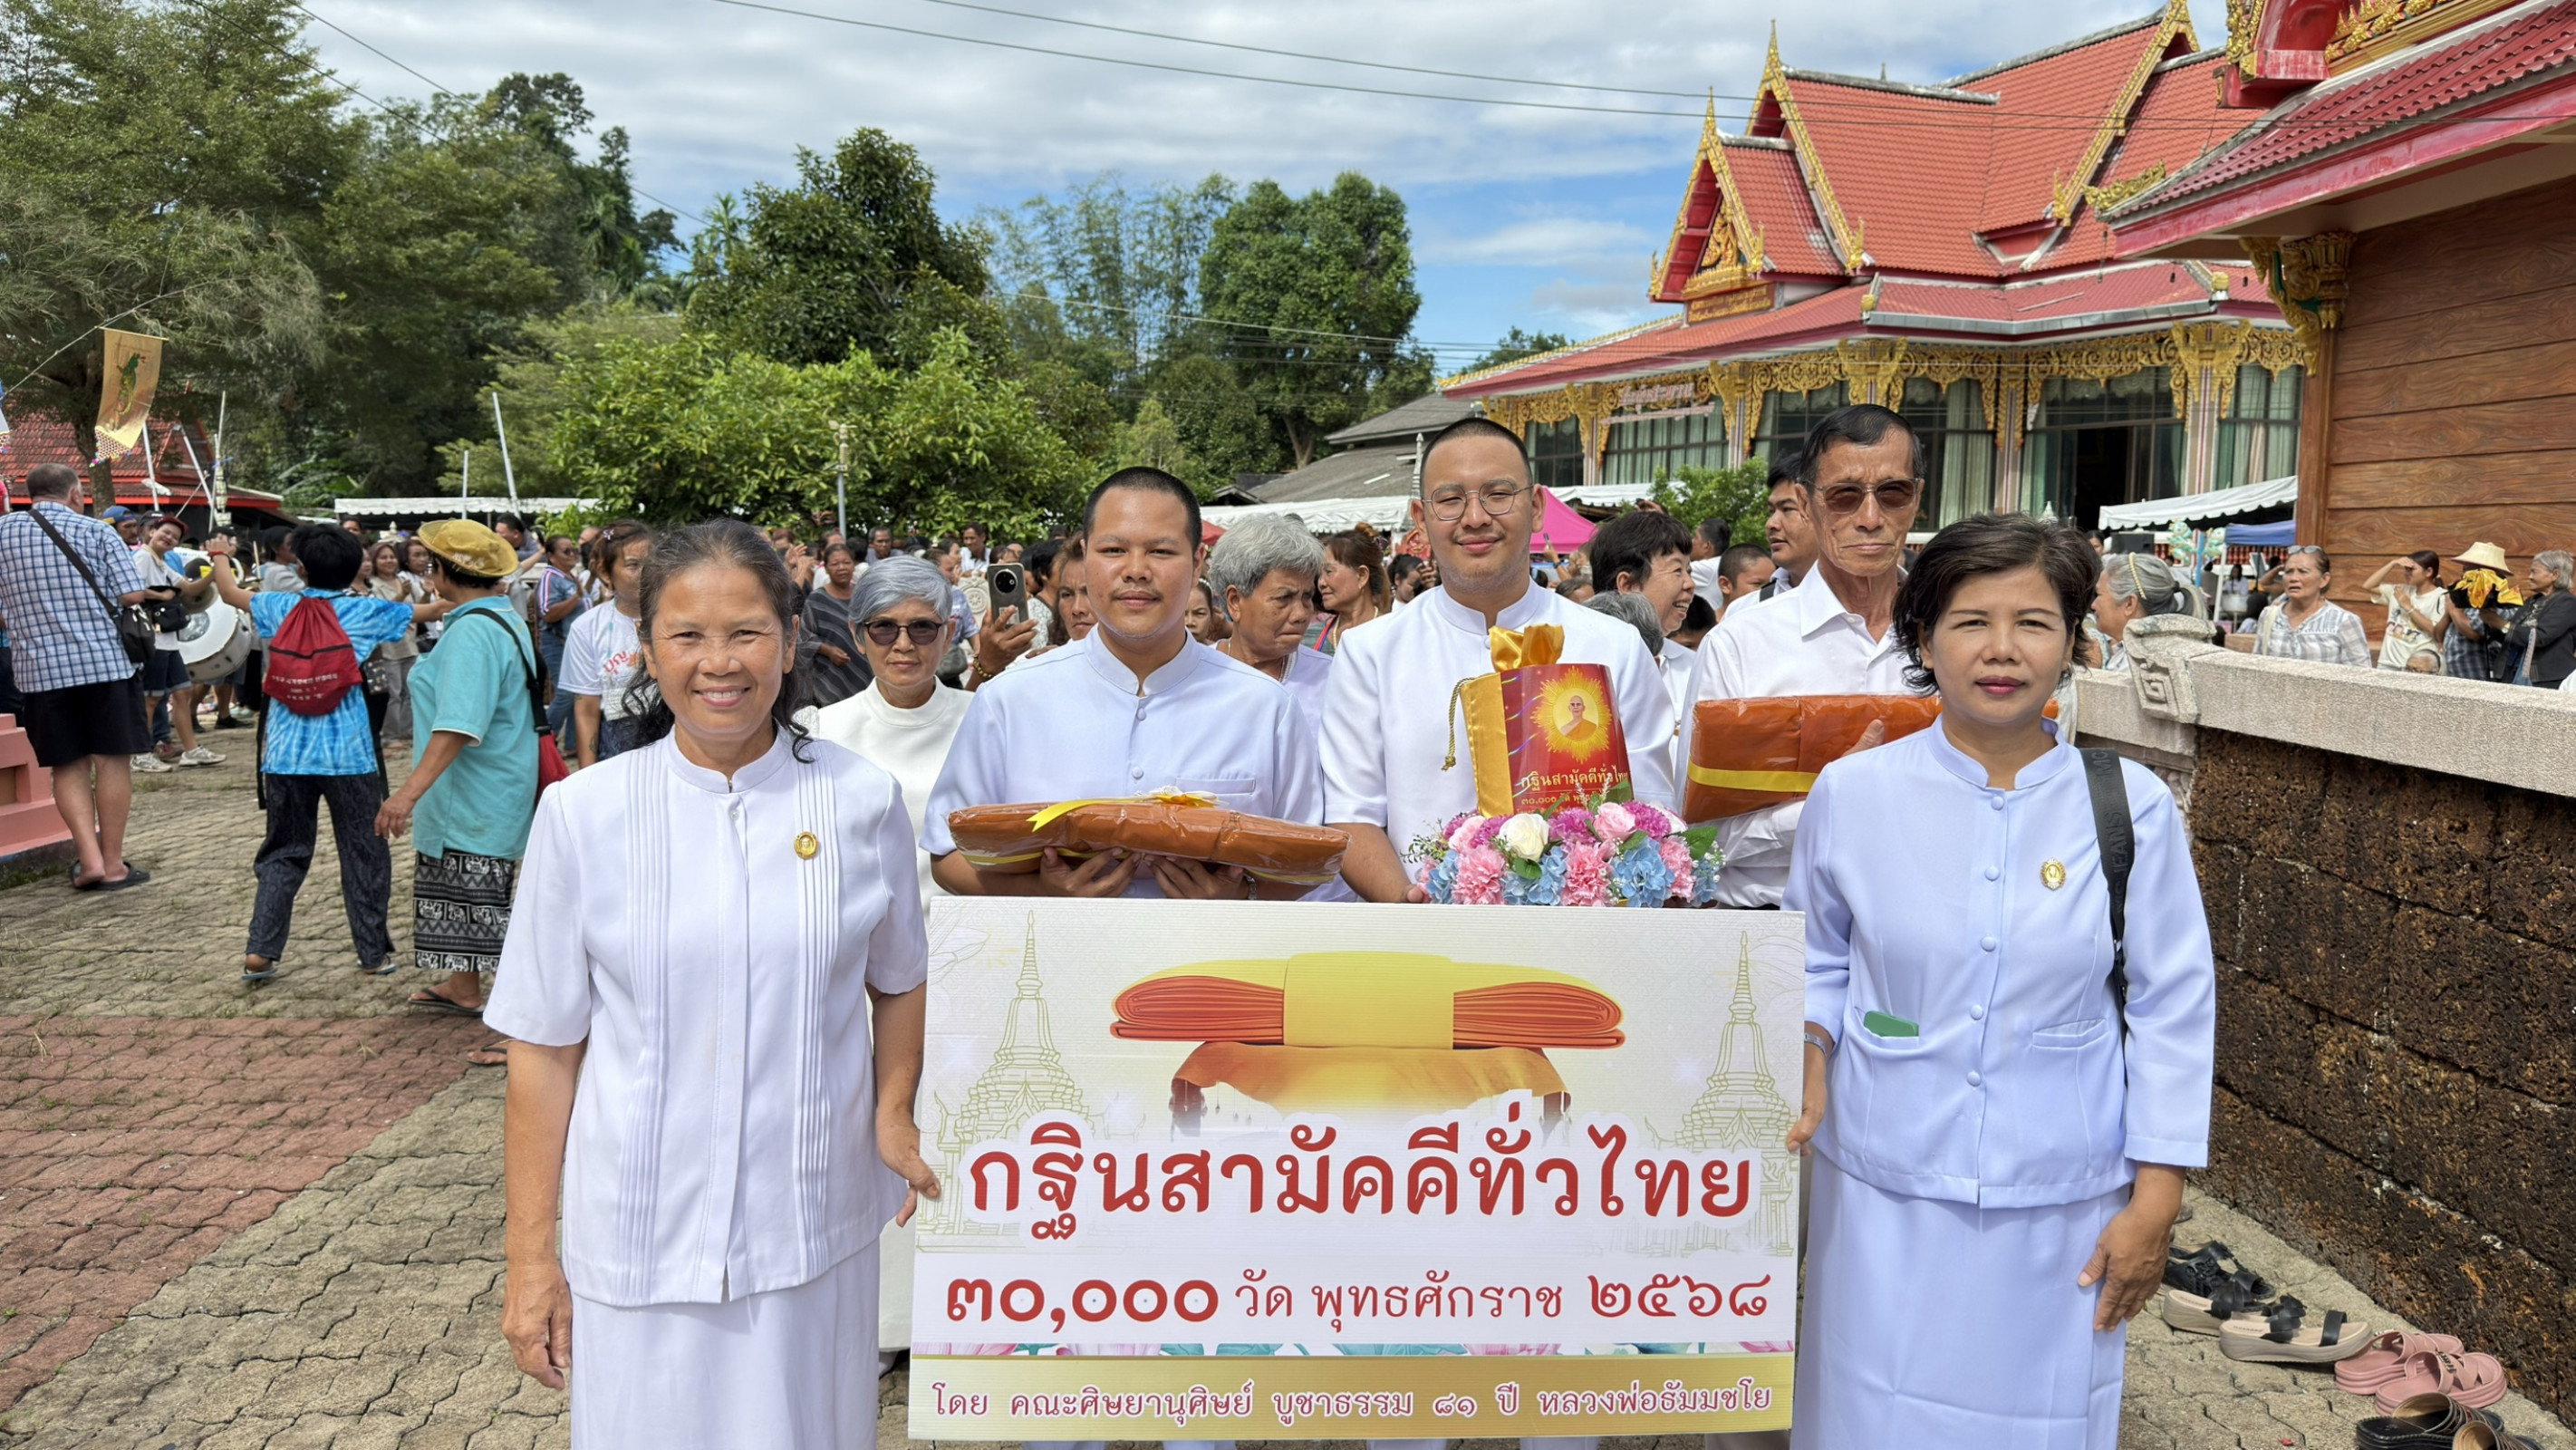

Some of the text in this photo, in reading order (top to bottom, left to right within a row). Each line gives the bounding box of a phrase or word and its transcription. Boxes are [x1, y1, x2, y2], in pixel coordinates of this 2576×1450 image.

[971, 1099, 1751, 1241] กฐินสามัคคีทั่วไทย
[948, 1269, 1771, 1333] ๓๐,๐๐๐ วัด พุทธศักราช ๒๕๖๘
[932, 1377, 1771, 1426] โดย คณะศิษยานุศิษย์ บูชาธรรม ๘๑ ปี หลวงพ่อธัมมชโย
